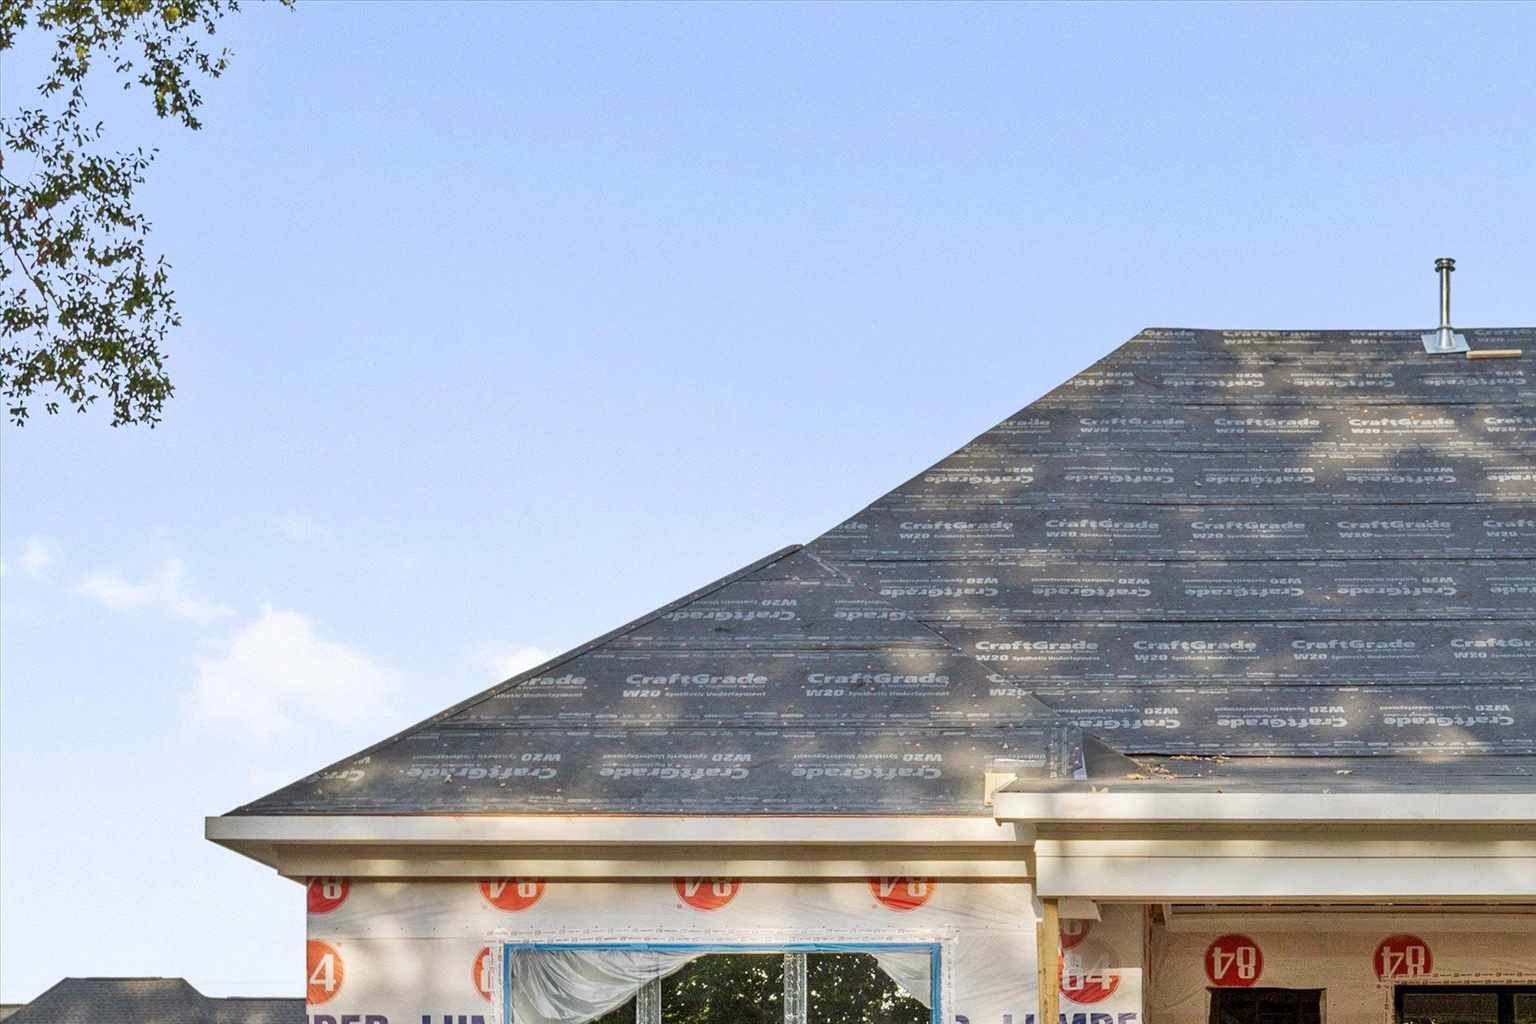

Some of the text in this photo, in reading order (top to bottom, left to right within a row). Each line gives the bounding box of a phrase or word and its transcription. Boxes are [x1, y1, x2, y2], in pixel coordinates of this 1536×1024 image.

[1214, 417, 1320, 427] CraftGrade
[1349, 417, 1456, 427] CraftGrade
[1064, 473, 1175, 484] CraftGrade
[1204, 473, 1316, 484] CraftGrade
[1346, 473, 1457, 484] CraftGrade
[899, 520, 1015, 531] CraftGrade
[1045, 518, 1160, 530] CraftGrade
[1190, 520, 1305, 531] CraftGrade
[1336, 519, 1452, 530] CraftGrade
[880, 586, 999, 598] CraftGrade
[1031, 586, 1152, 598] CraftGrade
[1185, 586, 1305, 598] CraftGrade
[1337, 585, 1458, 598] CraftGrade
[975, 640, 1099, 652] CraftGrade
[1133, 640, 1258, 652] CraftGrade
[1290, 639, 1417, 651] CraftGrade
[975, 654, 1009, 662] W20
[1133, 653, 1169, 662] W20
[1293, 652, 1328, 661] W20
[626, 673, 769, 687] CraftGrade
[808, 673, 951, 686] CraftGrade
[622, 689, 662, 698] W20
[806, 689, 845, 698] W20
[1308, 705, 1345, 714] W20
[1474, 703, 1512, 713] W20
[1217, 716, 1350, 729] CraftGrade
[1383, 715, 1515, 727] CraftGrade
[520, 752, 562, 762] W20
[711, 752, 753, 762] W20
[902, 752, 944, 762] W20
[599, 767, 750, 781] CraftGrade
[791, 766, 943, 781] CraftGrade
[1210, 946, 1257, 981] 84
[1380, 945, 1426, 977] 84
